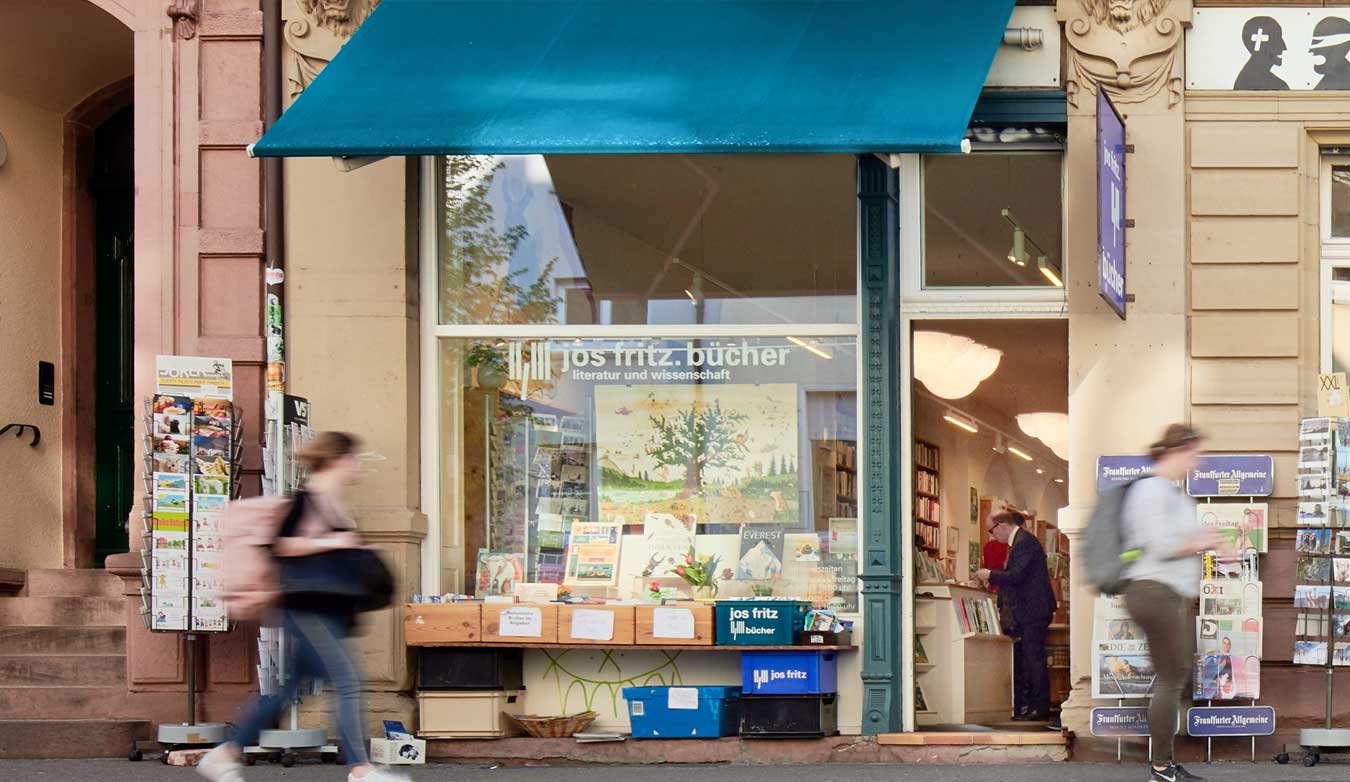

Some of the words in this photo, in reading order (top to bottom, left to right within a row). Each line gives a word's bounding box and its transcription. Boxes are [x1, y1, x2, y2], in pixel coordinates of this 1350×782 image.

[562, 343, 606, 372] jos
[687, 341, 791, 367] bücher
[572, 369, 621, 381] literatur
[624, 369, 648, 381] und
[650, 369, 731, 381] wissenschaft
[1320, 375, 1340, 392] XXL
[1103, 466, 1140, 478] Frankfurter
[1193, 469, 1230, 481] Frankfurter
[1230, 469, 1267, 480] Allgemeine
[743, 531, 782, 540] EVEREST
[729, 607, 750, 620] jos
[752, 607, 779, 619] fritz
[745, 626, 776, 635] bücher
[770, 669, 785, 681] jos
[786, 669, 807, 679] fritz
[1096, 713, 1136, 726] Frankfurter
[1193, 714, 1231, 727] Frankfurter
[1231, 714, 1268, 725] Allgemeine
